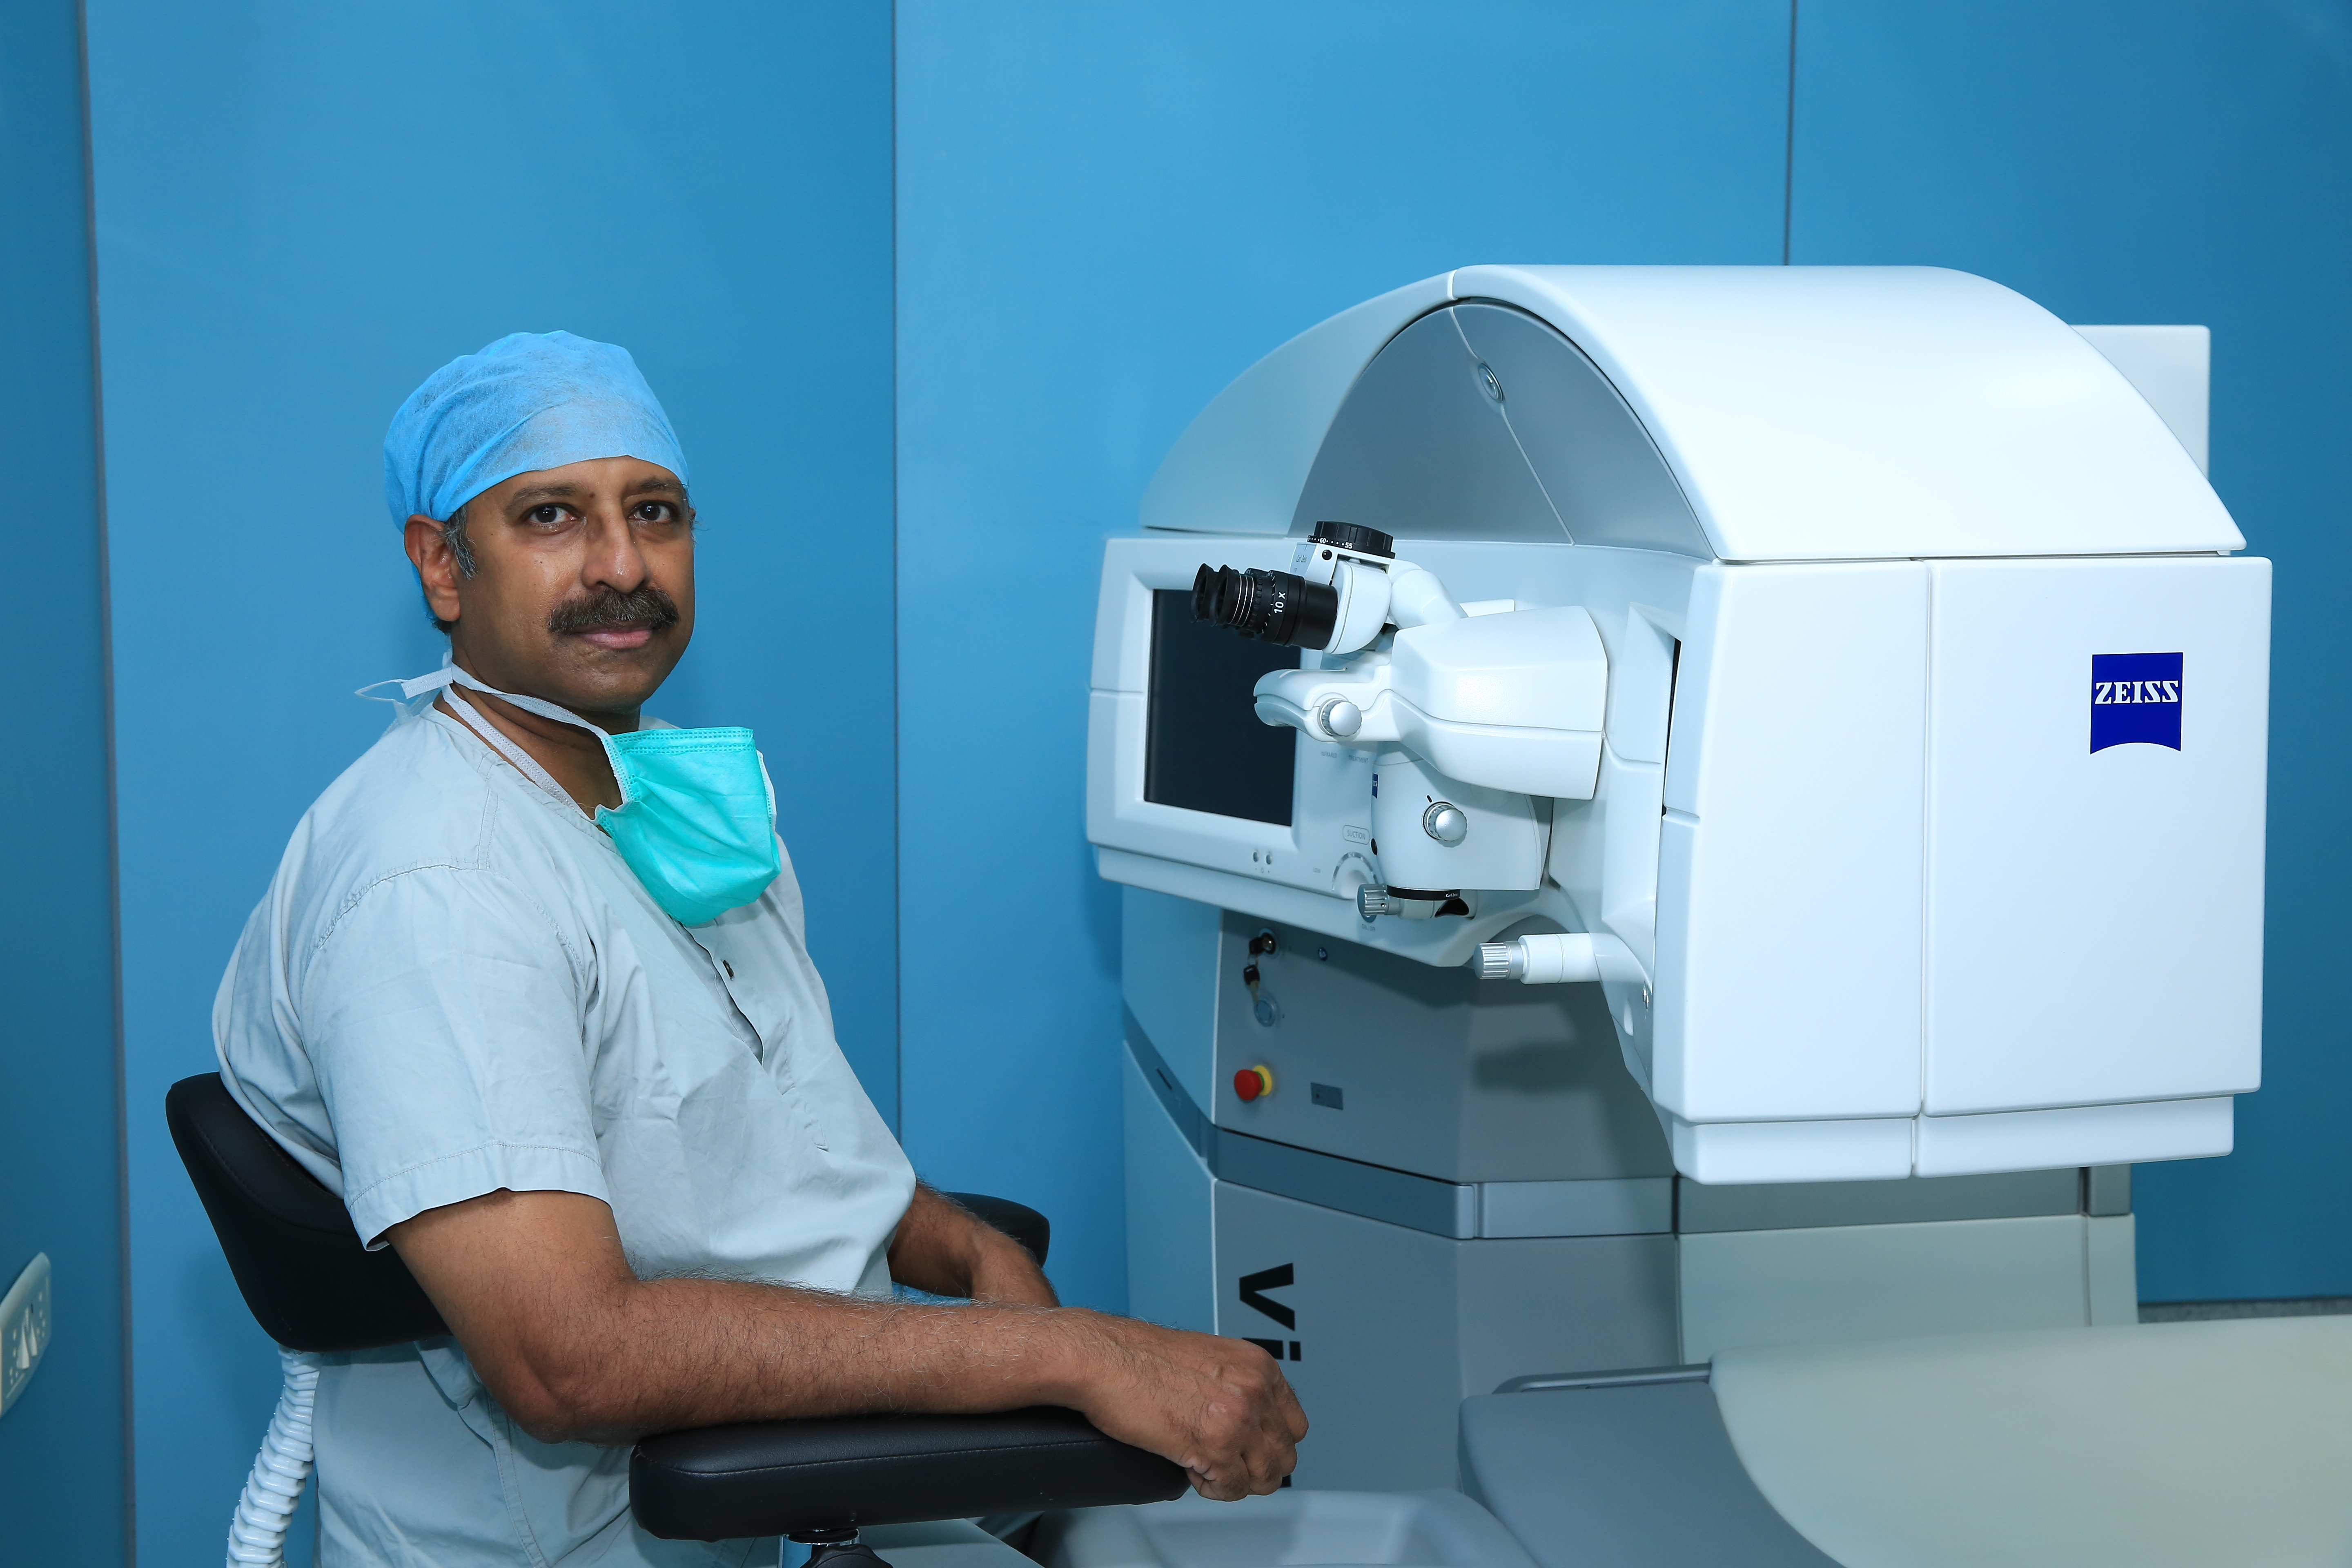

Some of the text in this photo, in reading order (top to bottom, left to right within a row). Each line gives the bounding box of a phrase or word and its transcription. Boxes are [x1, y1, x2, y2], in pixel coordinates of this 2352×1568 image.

[1274, 601, 1284, 613] 10
[2095, 680, 2178, 704] ZEISS
[1349, 755, 1368, 763] TREATMENT
[1347, 830, 1366, 840] SUCTION
